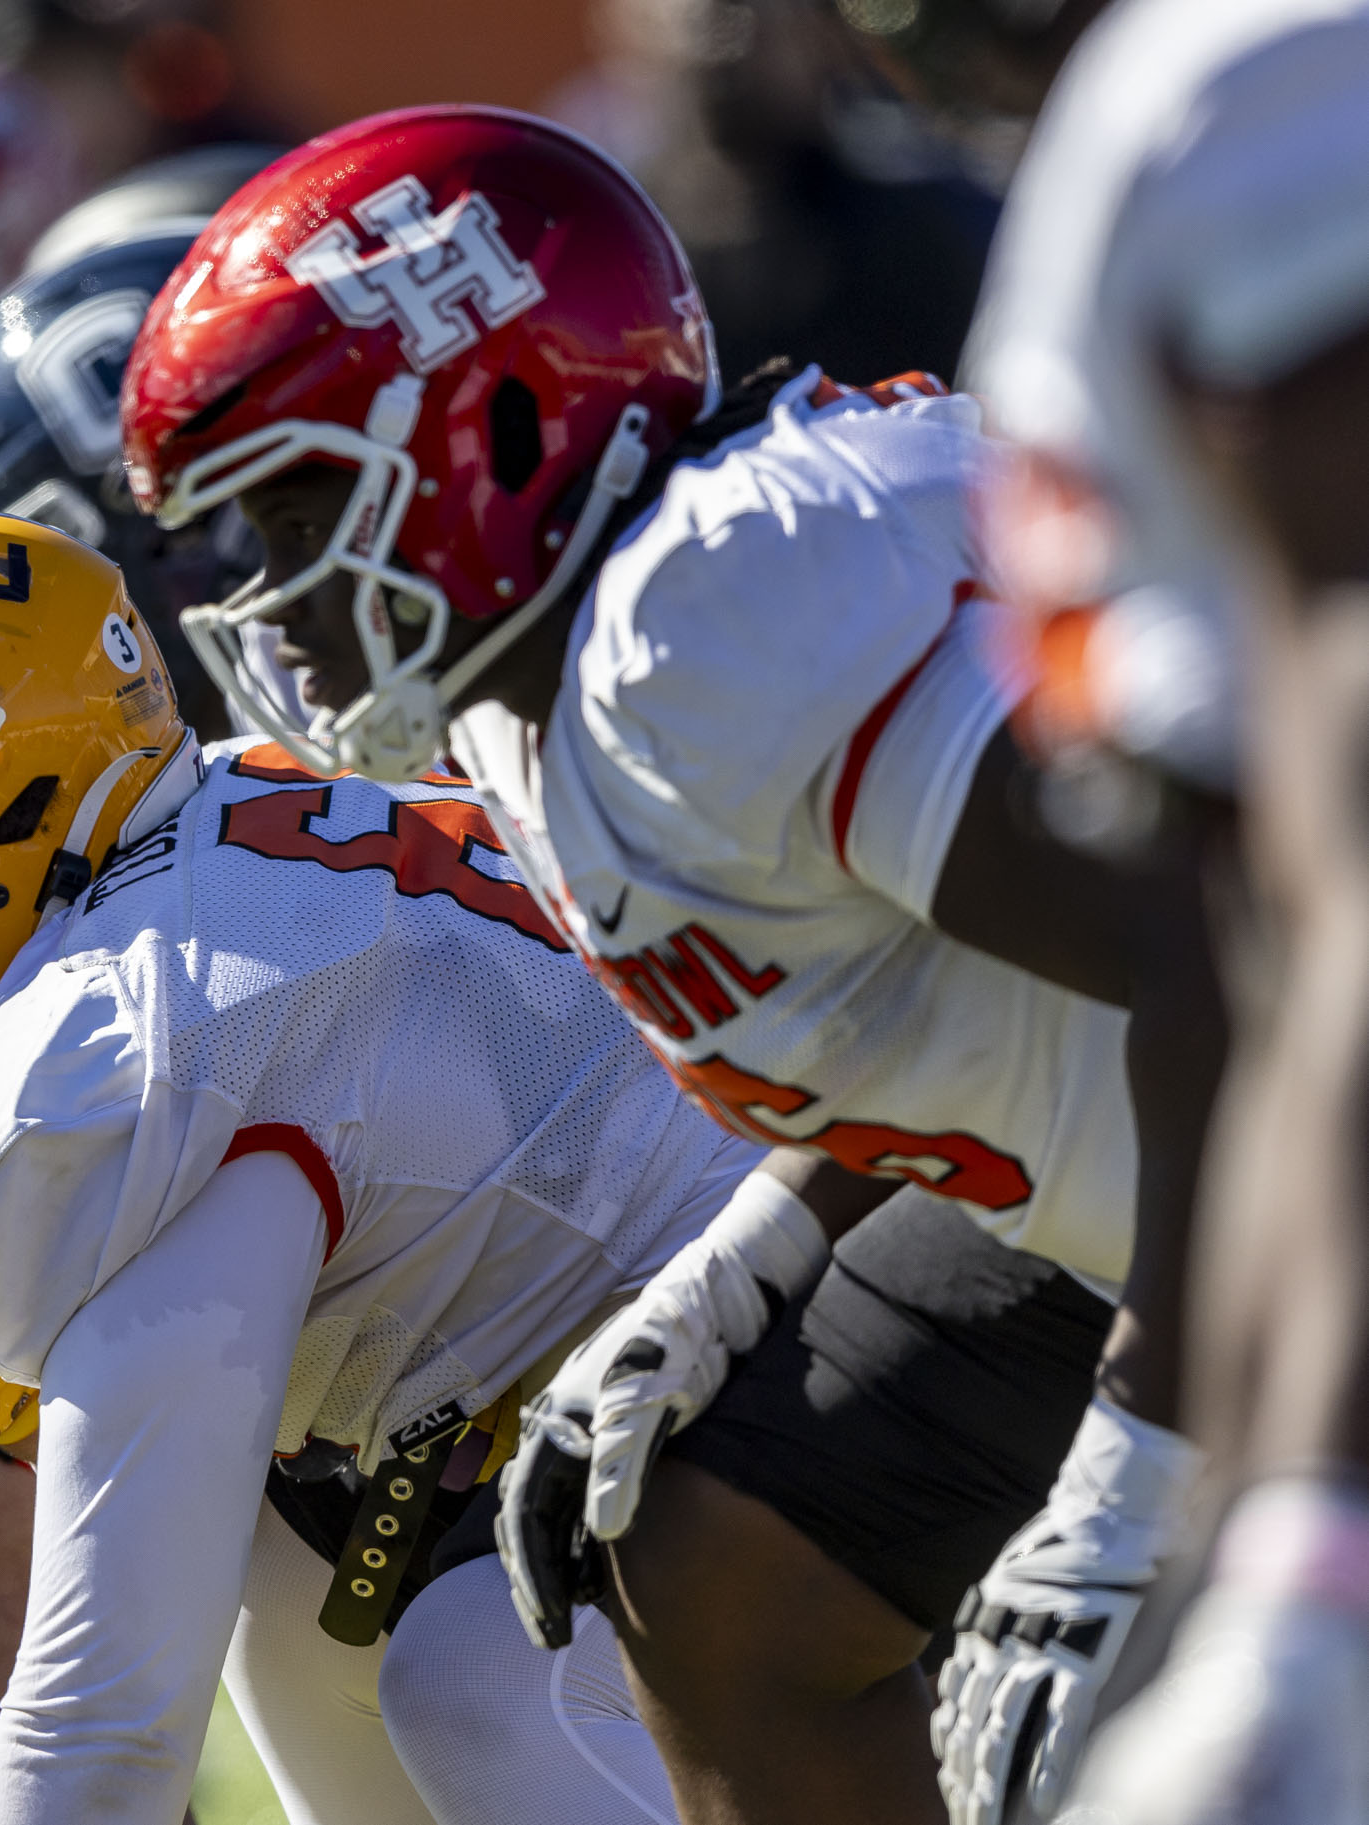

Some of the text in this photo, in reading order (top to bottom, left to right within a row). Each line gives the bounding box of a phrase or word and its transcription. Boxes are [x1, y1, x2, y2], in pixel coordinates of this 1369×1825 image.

[283, 174, 547, 377] UH
[110, 622, 136, 664] 3
[122, 676, 147, 693] DANGER
[593, 924, 789, 1041] OWL
[400, 1409, 453, 1444] 2XL
